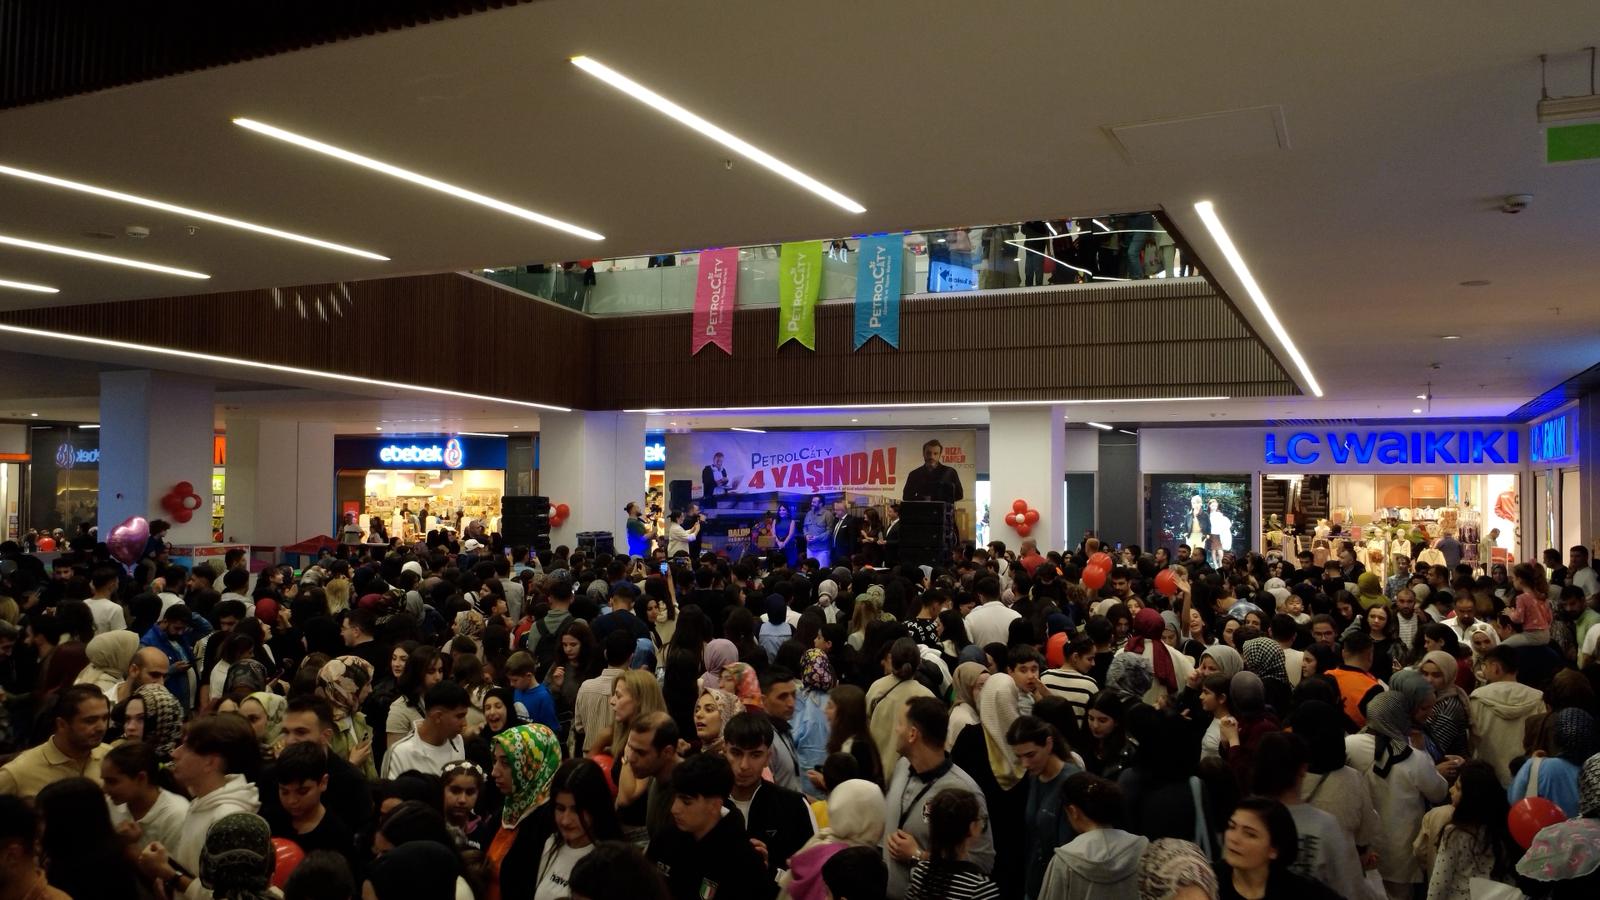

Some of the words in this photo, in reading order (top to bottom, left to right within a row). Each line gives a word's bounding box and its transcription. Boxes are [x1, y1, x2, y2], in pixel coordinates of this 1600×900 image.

[380, 445, 443, 462] ebebek
[1265, 432, 1320, 465] LC
[749, 470, 765, 489] 4
[771, 447, 897, 492] YAŞINDA!
